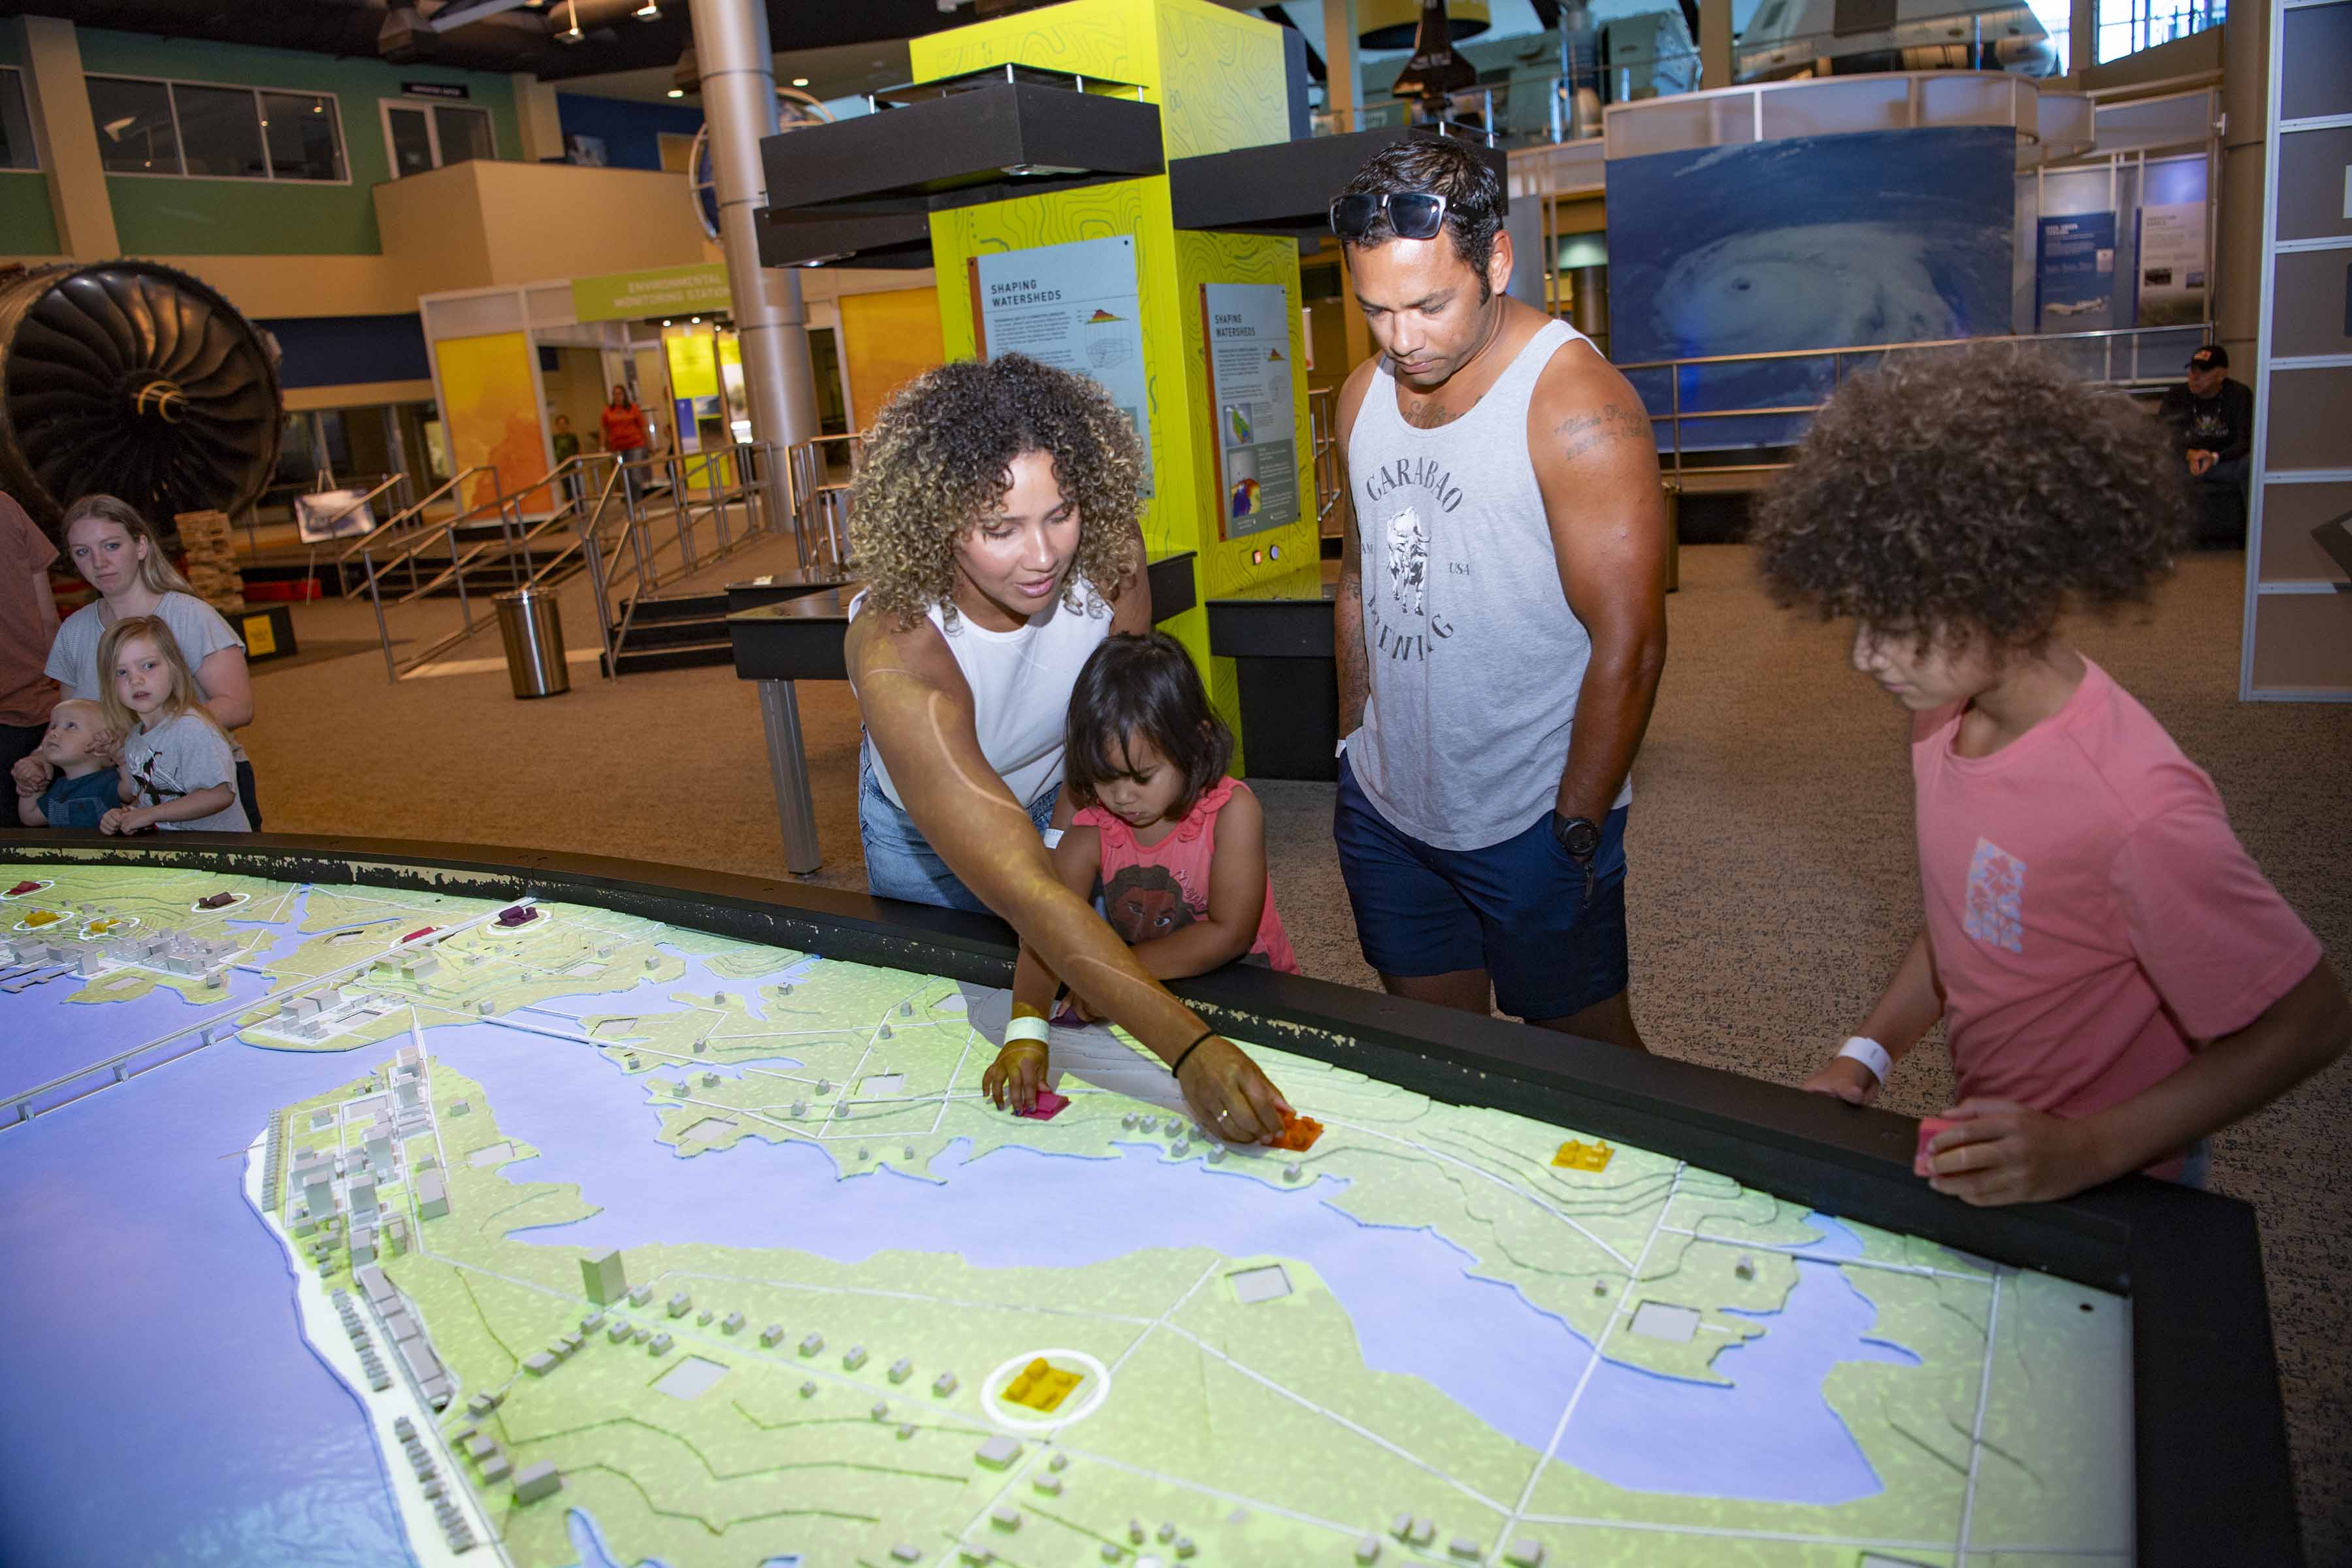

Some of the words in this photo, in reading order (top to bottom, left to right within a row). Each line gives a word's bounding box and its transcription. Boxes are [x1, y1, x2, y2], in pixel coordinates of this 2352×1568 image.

[990, 279, 1037, 295] SHAPING
[992, 289, 1062, 307] WATERSHEDS
[1215, 314, 1242, 324] SHAPING
[1216, 327, 1256, 337] WATERSHEDS
[1366, 457, 1463, 513] CARABAO
[1449, 562, 1470, 575] USA
